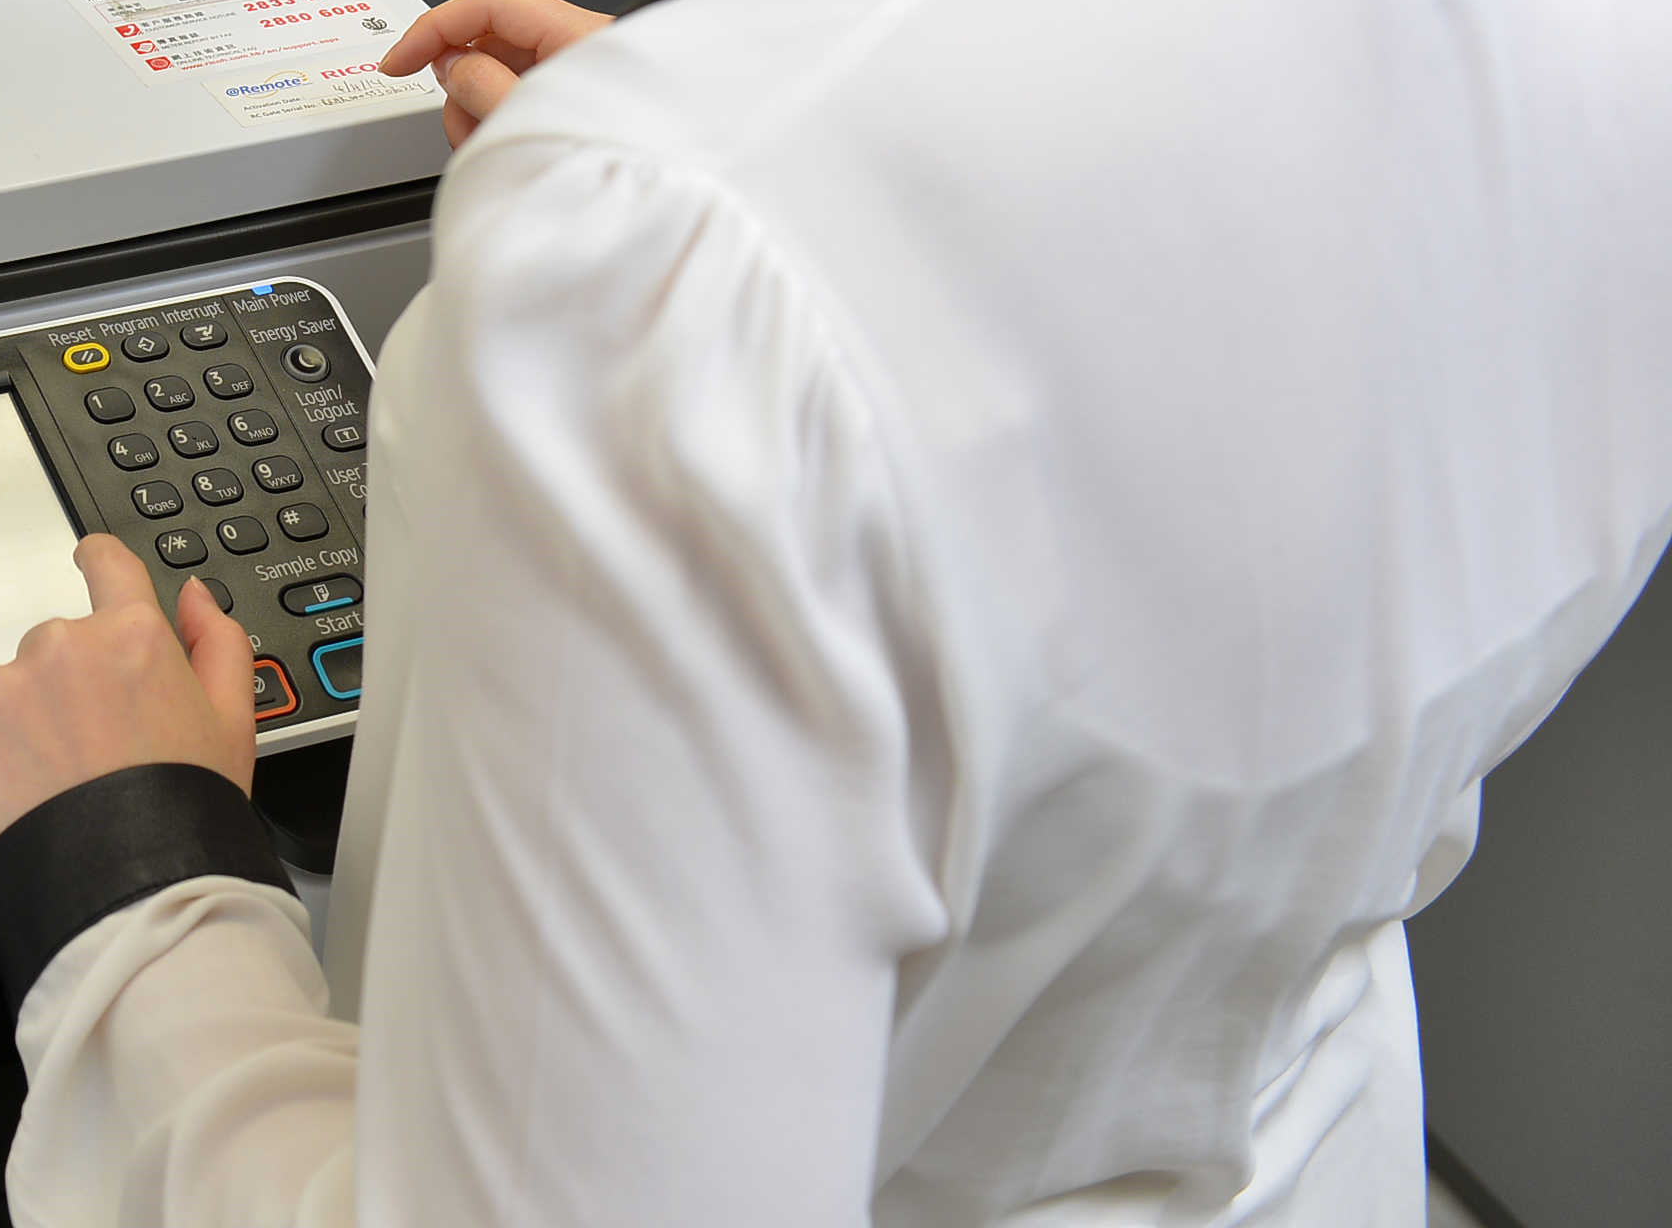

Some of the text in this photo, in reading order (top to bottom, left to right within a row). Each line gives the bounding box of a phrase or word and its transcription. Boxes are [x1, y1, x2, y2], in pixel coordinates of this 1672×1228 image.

[259, 2, 371, 28] 2880 6088
[320, 62, 380, 79] RICO
[226, 77, 302, 97] @Remote
[233, 288, 312, 314] Main Power
[48, 300, 225, 347] Reset Program Interrupt
[249, 316, 337, 344] Energy Saver
[208, 371, 224, 386] 3
[231, 380, 250, 392] DEF
[149, 383, 166, 397] 2
[169, 392, 190, 404] ABC
[295, 384, 343, 408] Login/
[91, 394, 104, 409] 1
[303, 400, 361, 424] Logout
[233, 416, 249, 432] 6
[172, 428, 188, 444] 5
[248, 427, 274, 440] MNO
[114, 441, 129, 456] 4
[195, 440, 215, 451] JKL
[134, 451, 154, 463] GHI
[257, 462, 273, 479] 9
[326, 466, 362, 485] User
[197, 475, 214, 491] 8
[266, 473, 300, 488] WXYZ
[135, 488, 149, 505] 7
[215, 486, 239, 500] TUV
[147, 499, 178, 513] PQRS
[222, 524, 238, 540] 0
[254, 546, 360, 582] Sample Copy
[314, 610, 364, 635] Start
